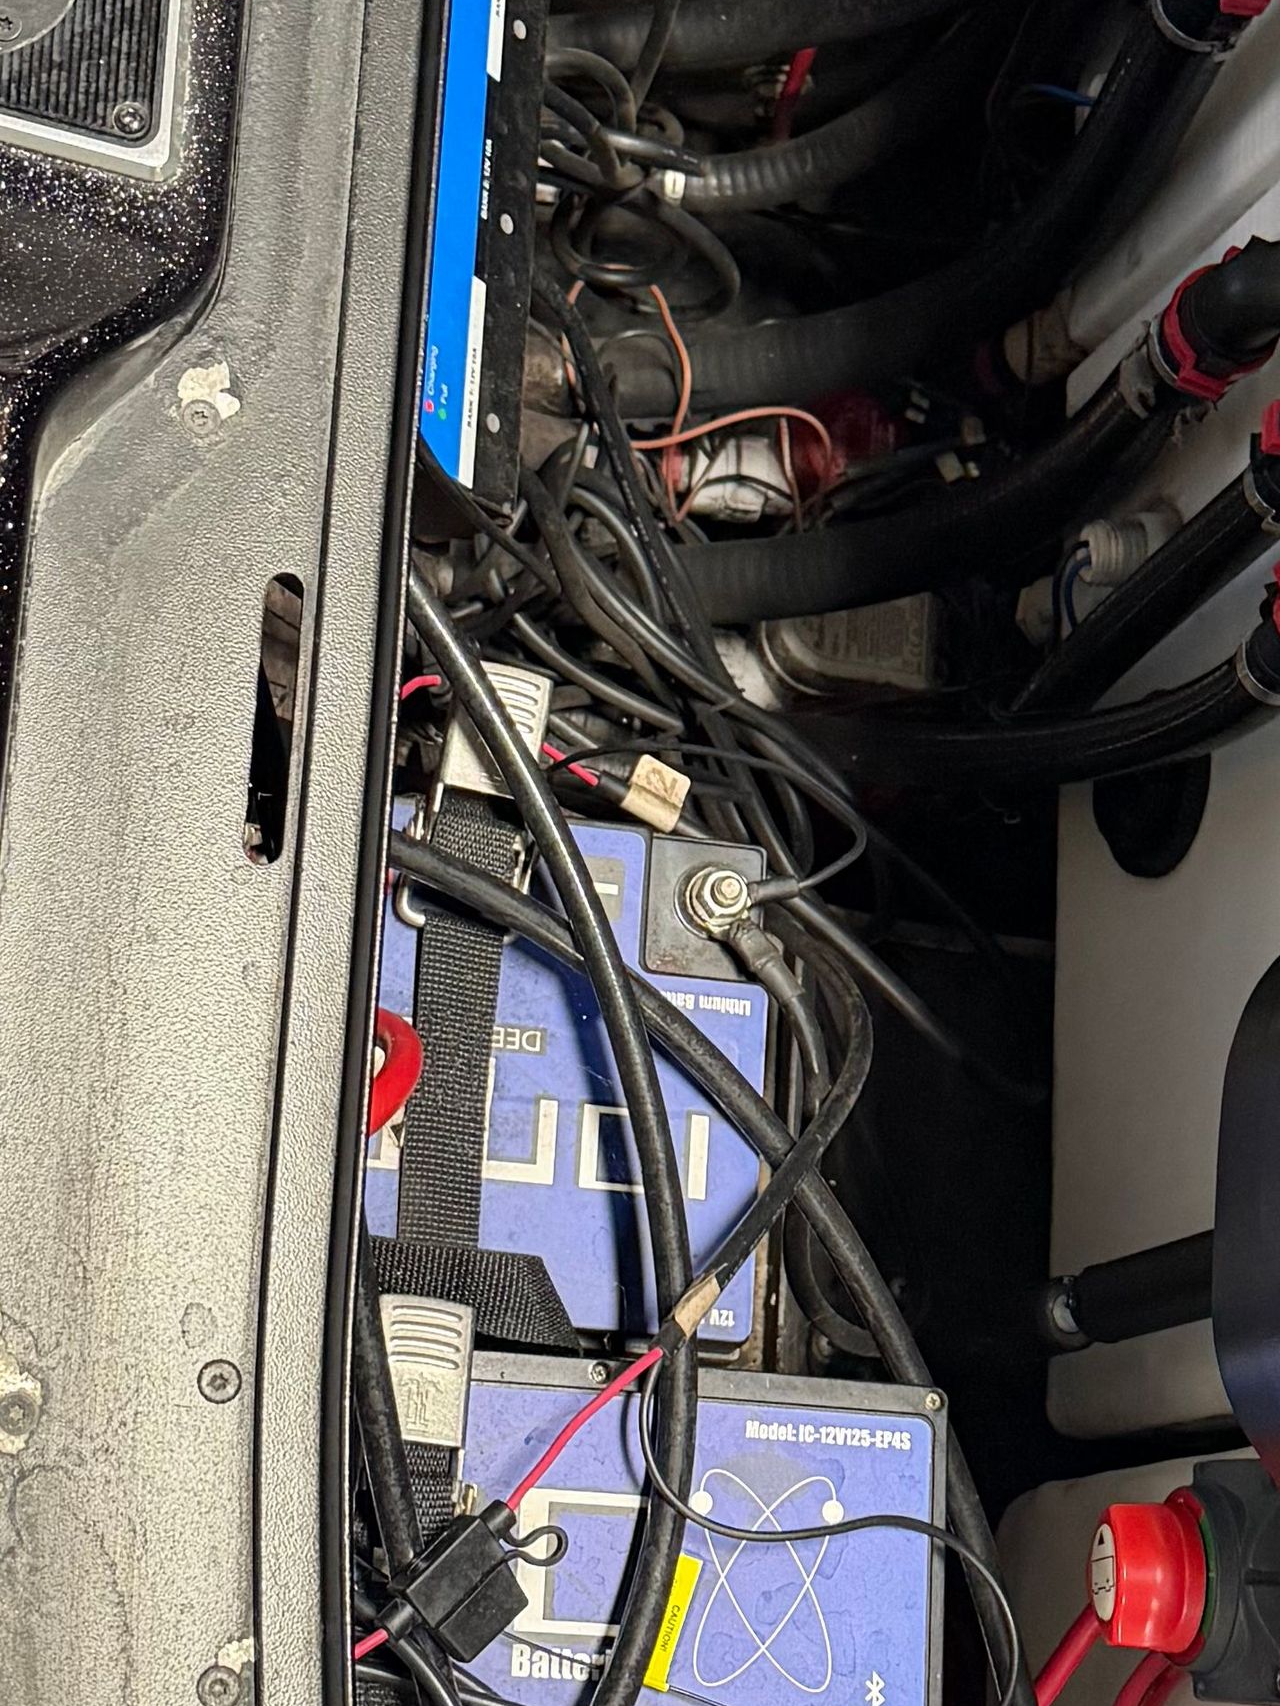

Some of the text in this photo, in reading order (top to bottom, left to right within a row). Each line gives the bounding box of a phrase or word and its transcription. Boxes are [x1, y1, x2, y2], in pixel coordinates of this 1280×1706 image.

[424, 344, 441, 396] Charging
[439, 382, 448, 404] Full
[698, 993, 751, 1016] Lithium
[489, 1025, 542, 1052] DEE
[709, 1308, 735, 1326] 12V
[744, 1420, 912, 1451] Model: IC-12V125-EP4S
[658, 1603, 681, 1653] CAUTION!
